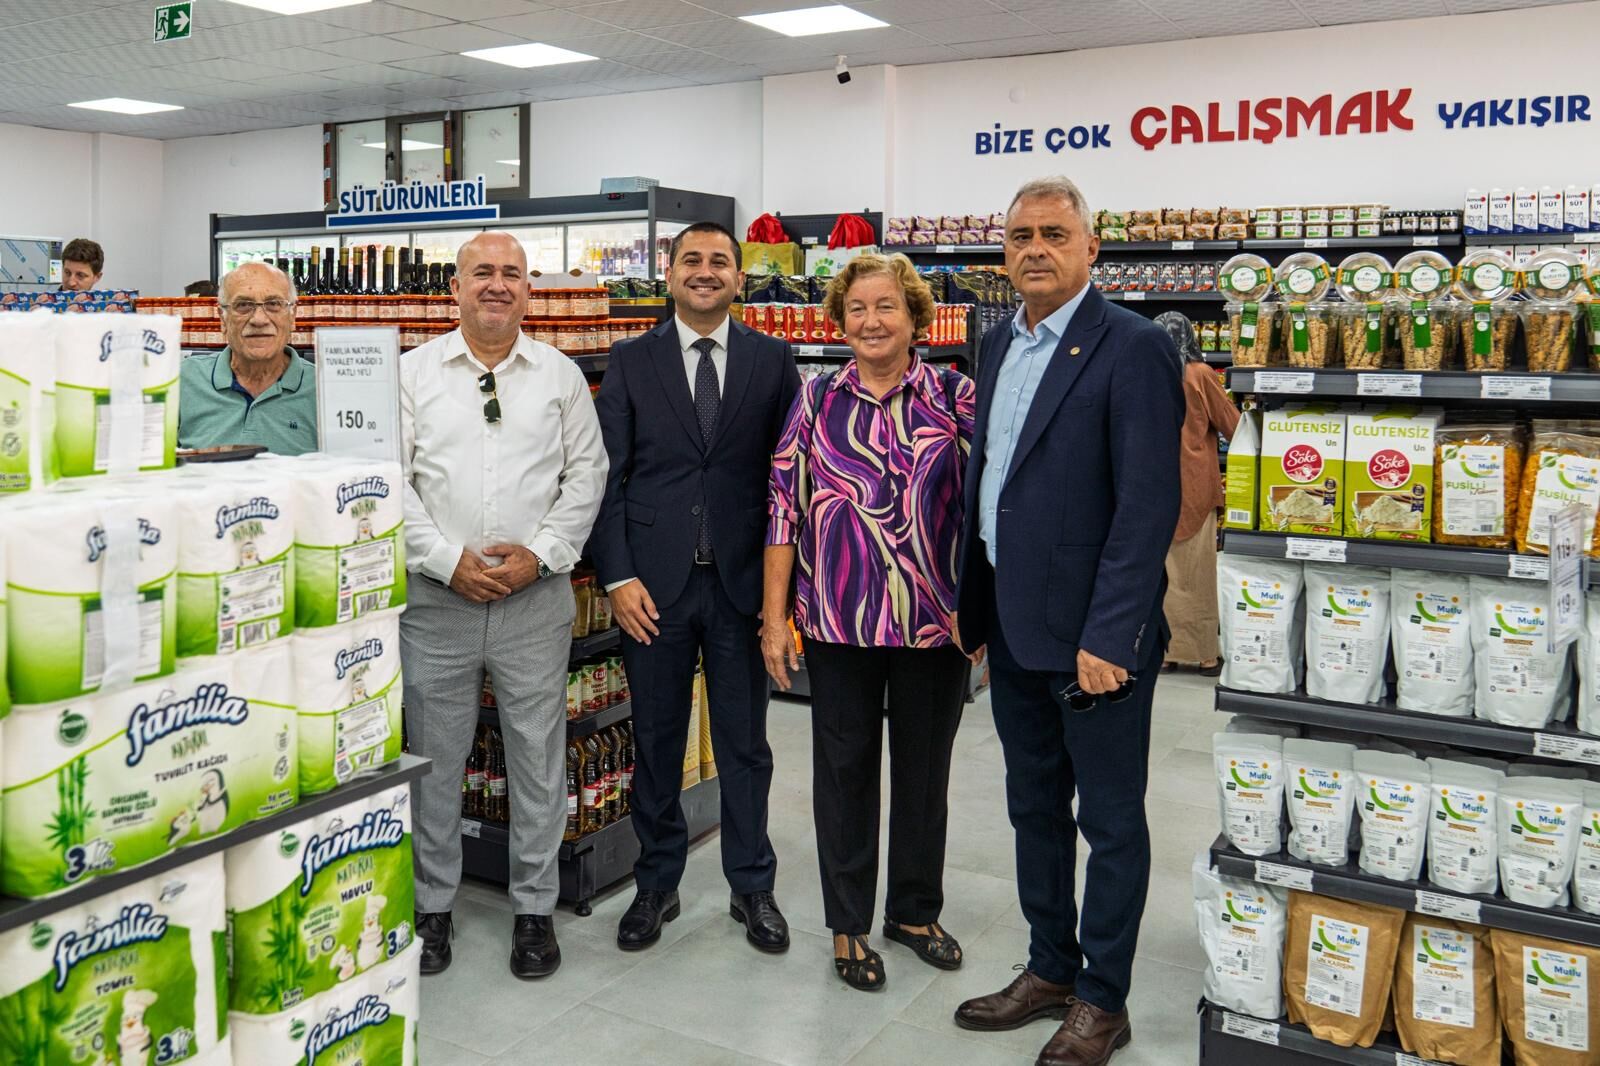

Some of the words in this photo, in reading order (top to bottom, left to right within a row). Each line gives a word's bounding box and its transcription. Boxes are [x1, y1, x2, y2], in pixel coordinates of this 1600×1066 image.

[975, 123, 1033, 155] BİZE
[1045, 124, 1111, 154] ÇOK
[1130, 88, 1414, 150] ÇALIŞMAK
[1438, 95, 1591, 129] YAKIŞIR
[340, 185, 377, 213] SÜT
[383, 176, 483, 211] ÜRÜNLERİ
[336, 410, 364, 429] 150
[1268, 421, 1341, 434] GLUTENSİZ
[1353, 425, 1430, 439] GLUTENSİZ
[1413, 444, 1426, 452] Un
[1286, 450, 1318, 467] Söke
[1372, 455, 1406, 472] Söke
[337, 476, 390, 514] familia
[216, 497, 280, 539] familia
[1261, 592, 1284, 600] Mutlu
[1347, 598, 1372, 607] Mutlu
[1437, 605, 1462, 614] Mutlu
[1517, 616, 1545, 625] Mutlu
[126, 683, 249, 767] familia
[1249, 771, 1272, 780] Mutlu
[1319, 781, 1342, 790] Mutlu
[1389, 793, 1415, 803] Mutlu
[1462, 803, 1488, 813] Mutlu
[1538, 815, 1566, 825] Mutlu
[300, 809, 403, 897] familia
[65, 847, 87, 880] 3
[341, 881, 373, 901] HAVLU
[1244, 905, 1267, 915] Mutlu
[53, 902, 168, 993] familia
[387, 930, 397, 956] 3
[1337, 934, 1361, 946] Mutlu
[1442, 943, 1467, 953] Mutlu
[1554, 965, 1582, 977] Mutlu
[96, 976, 135, 996] TOWEL
[305, 995, 390, 1066] familia
[157, 1035, 174, 1063] 3
